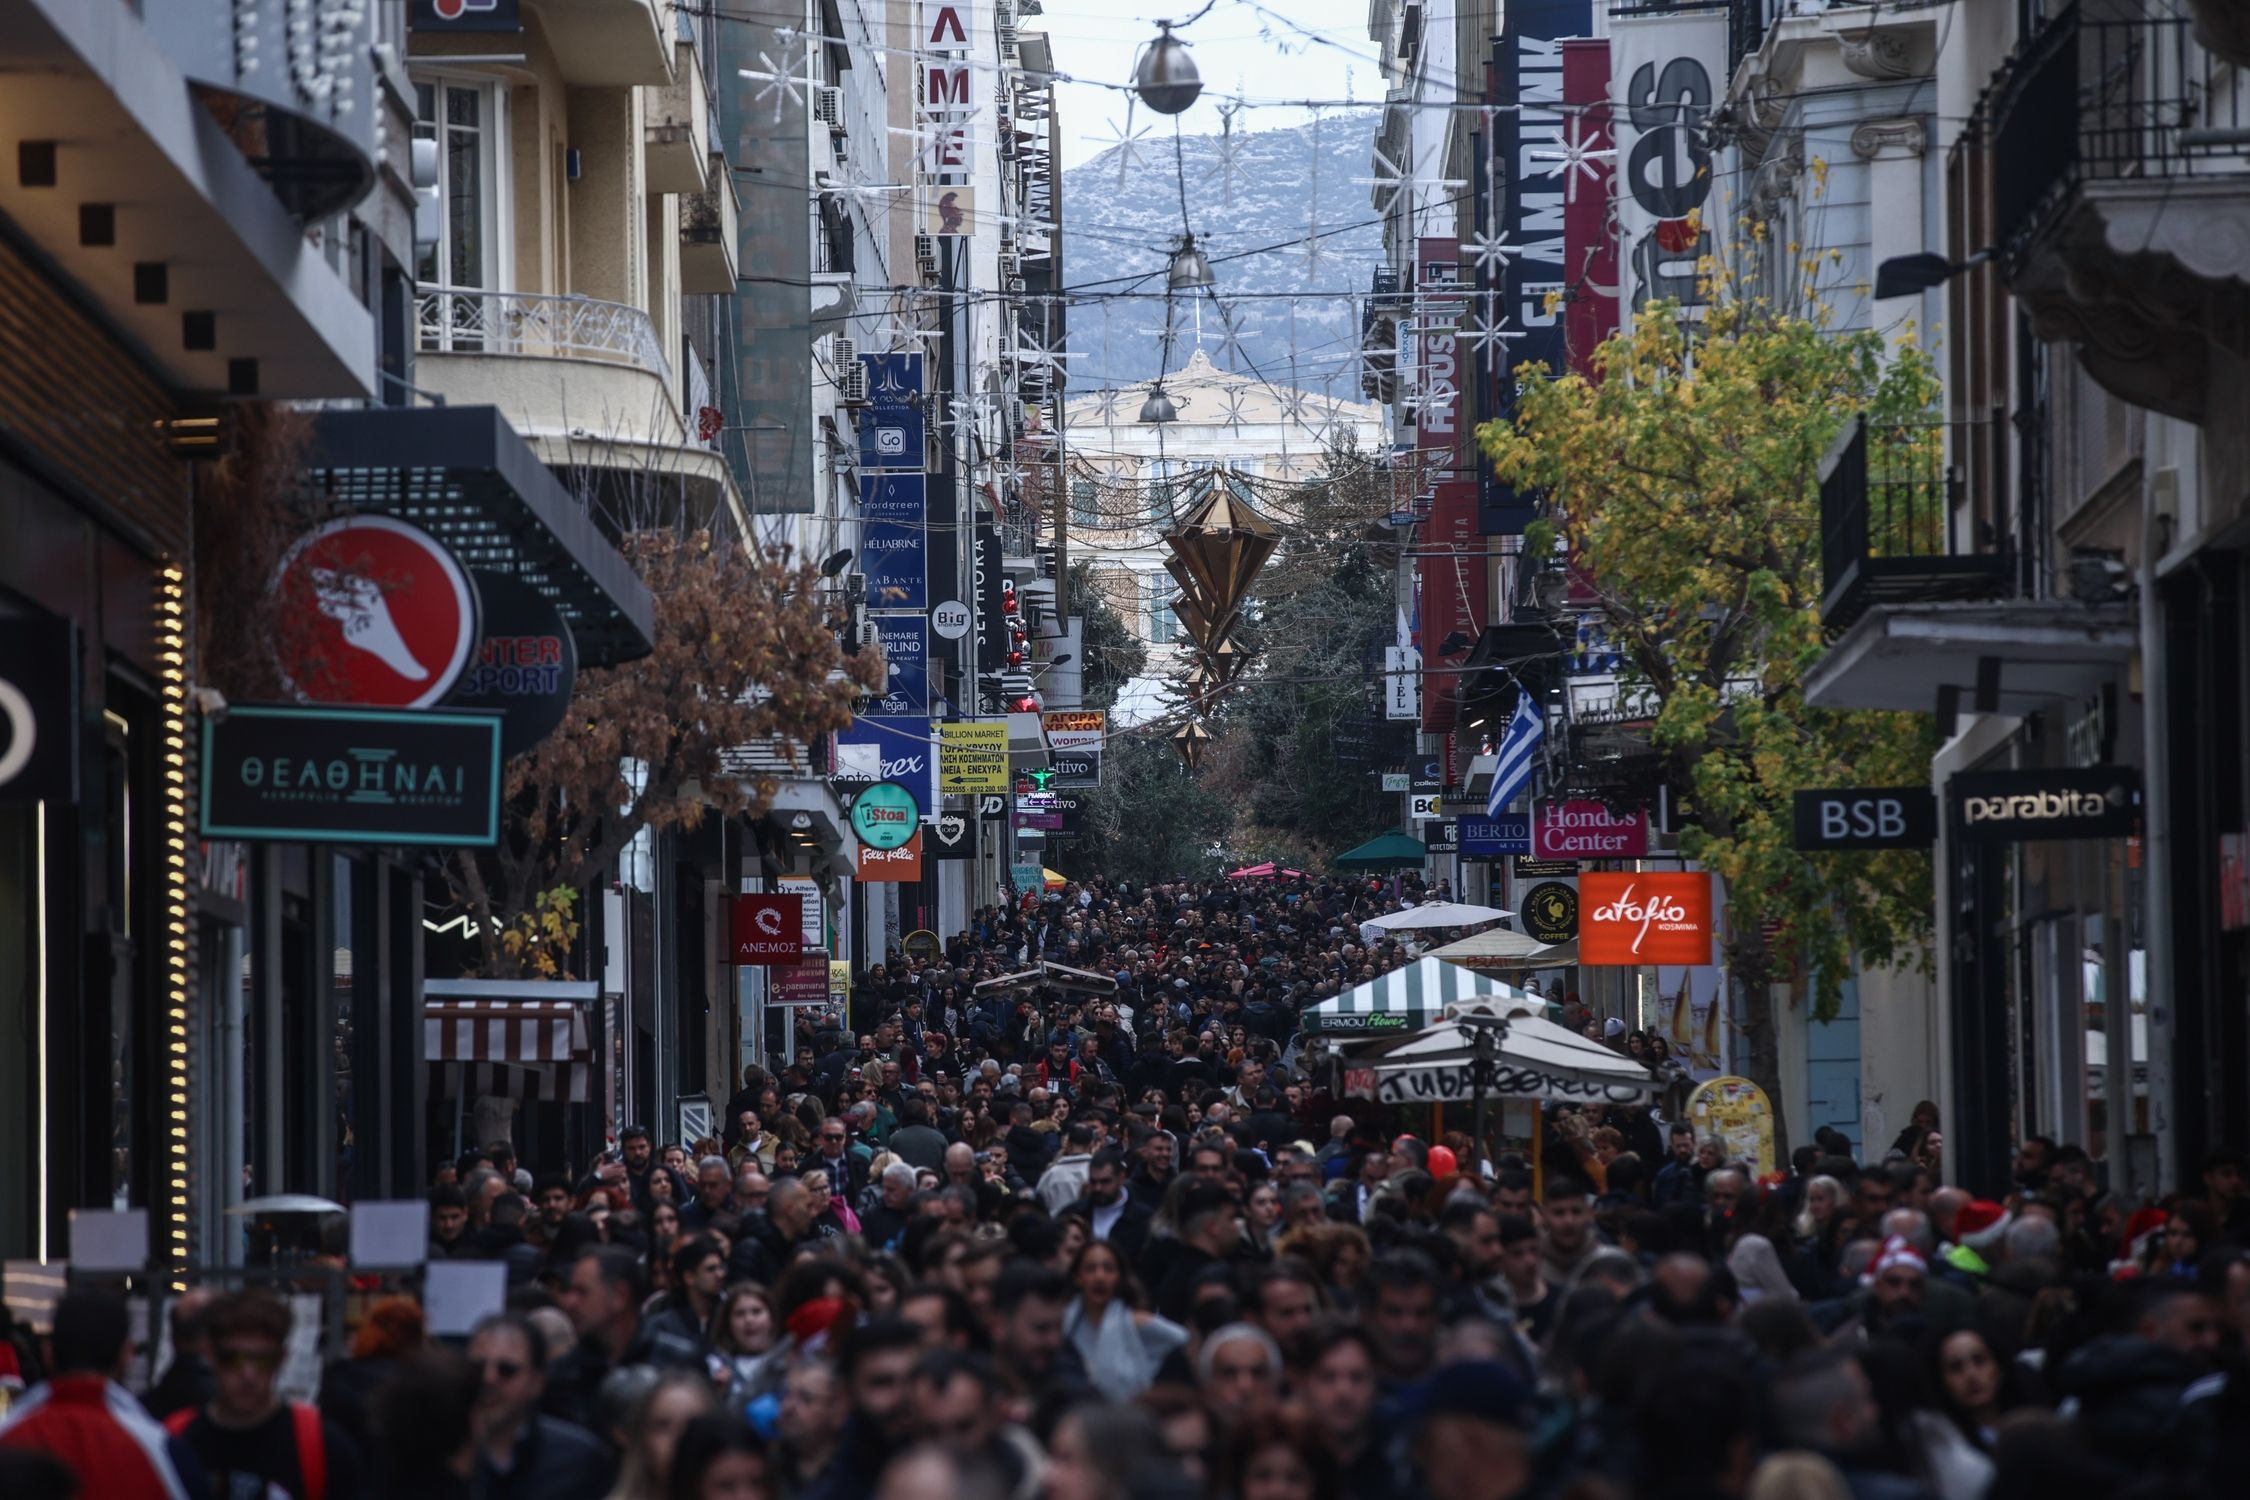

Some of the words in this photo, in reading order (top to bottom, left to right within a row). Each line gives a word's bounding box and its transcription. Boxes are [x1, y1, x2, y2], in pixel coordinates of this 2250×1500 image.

[880, 432, 900, 446] Go
[864, 500, 920, 510] nordgreen
[864, 537, 920, 549] HÉLIABRINE
[938, 611, 964, 626] Big
[479, 637, 561, 664] NTER
[886, 641, 921, 652] RLIND
[880, 699, 908, 713] Vegan
[1050, 713, 1097, 722] ΑΓΟΡΑ
[1046, 722, 1102, 731] ΧΡΥΣΟΥ
[975, 730, 1004, 738] MARKET
[967, 765, 1002, 774] ΕΝΕΧΥΡΑ
[1414, 779, 1440, 787] collec
[1964, 790, 2104, 825] parabita
[866, 808, 906, 821] iStoa
[1821, 799, 1907, 839] BSB
[1467, 824, 1525, 838] BERTO
[1544, 827, 1629, 851] Center
[1539, 932, 1570, 940] COFFEE
[740, 942, 797, 953] ΑΝΕΜΟΣ
[1321, 1016, 1367, 1029] ERMOU
[1367, 1012, 1406, 1027] Flower
